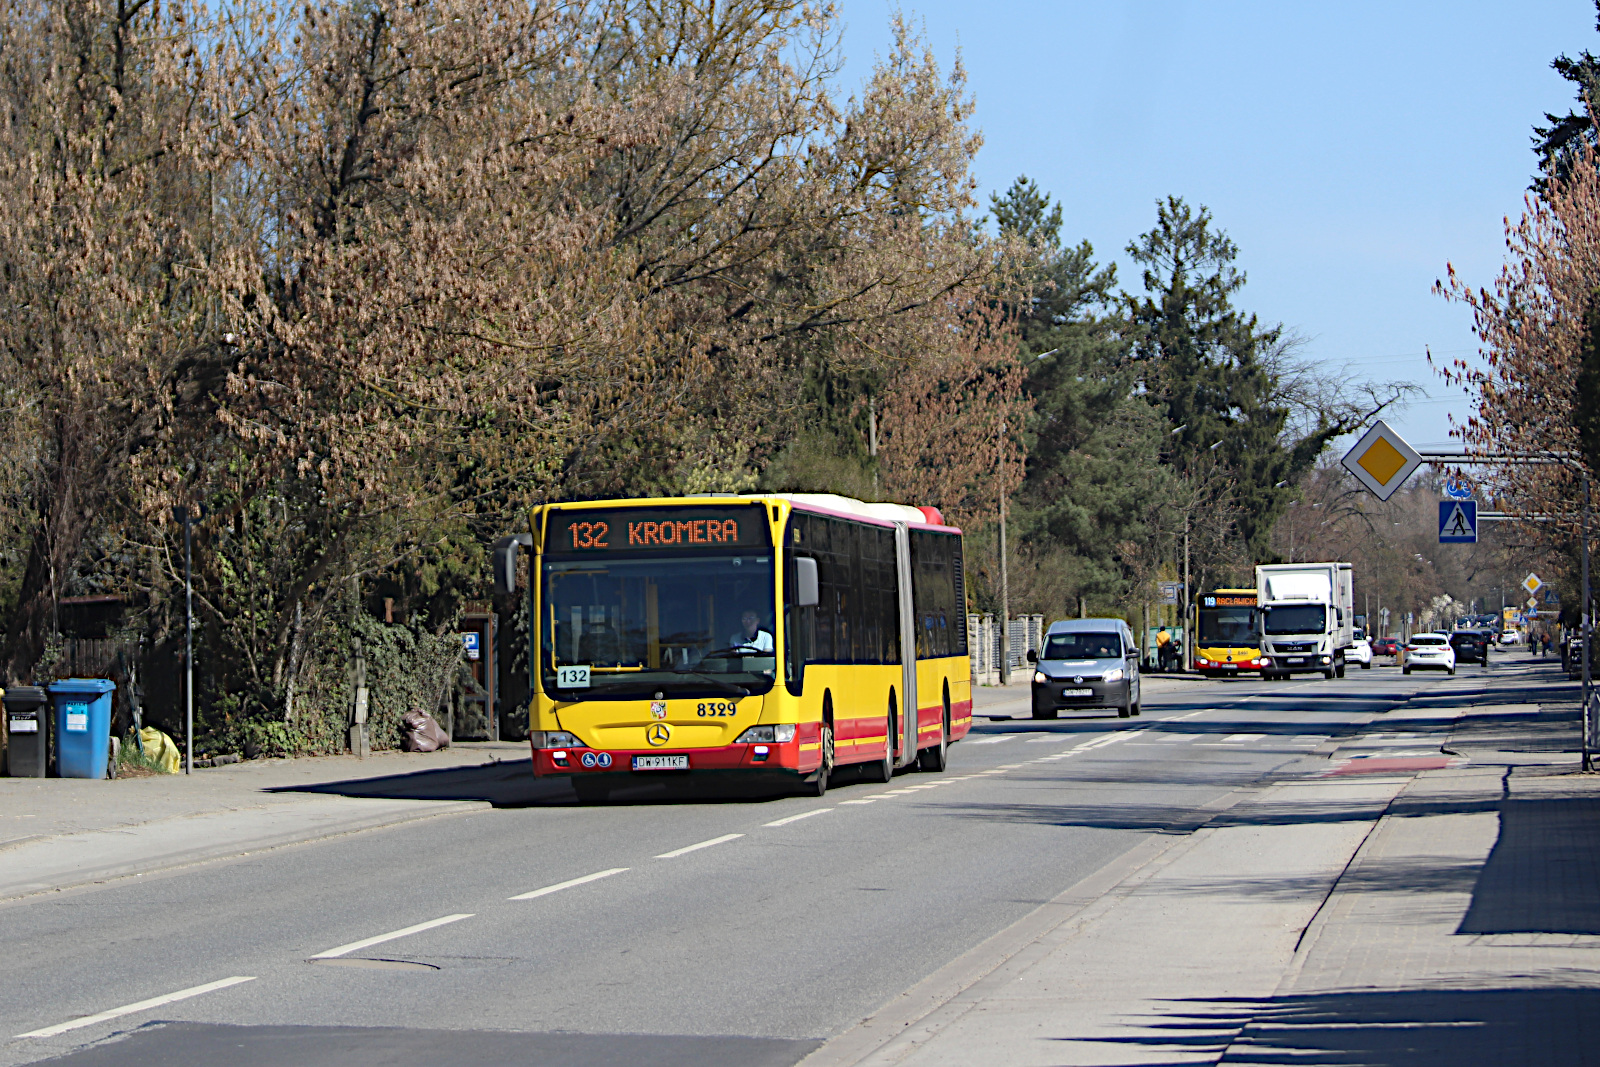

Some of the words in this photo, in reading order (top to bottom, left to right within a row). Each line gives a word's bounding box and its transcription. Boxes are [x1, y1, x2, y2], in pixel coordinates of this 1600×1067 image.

[568, 521, 609, 548] 132
[628, 519, 738, 545] KROMERA
[1204, 596, 1216, 607] 119
[559, 669, 587, 683] 132
[696, 702, 737, 717] 8329
[654, 756, 685, 767] 911KF
